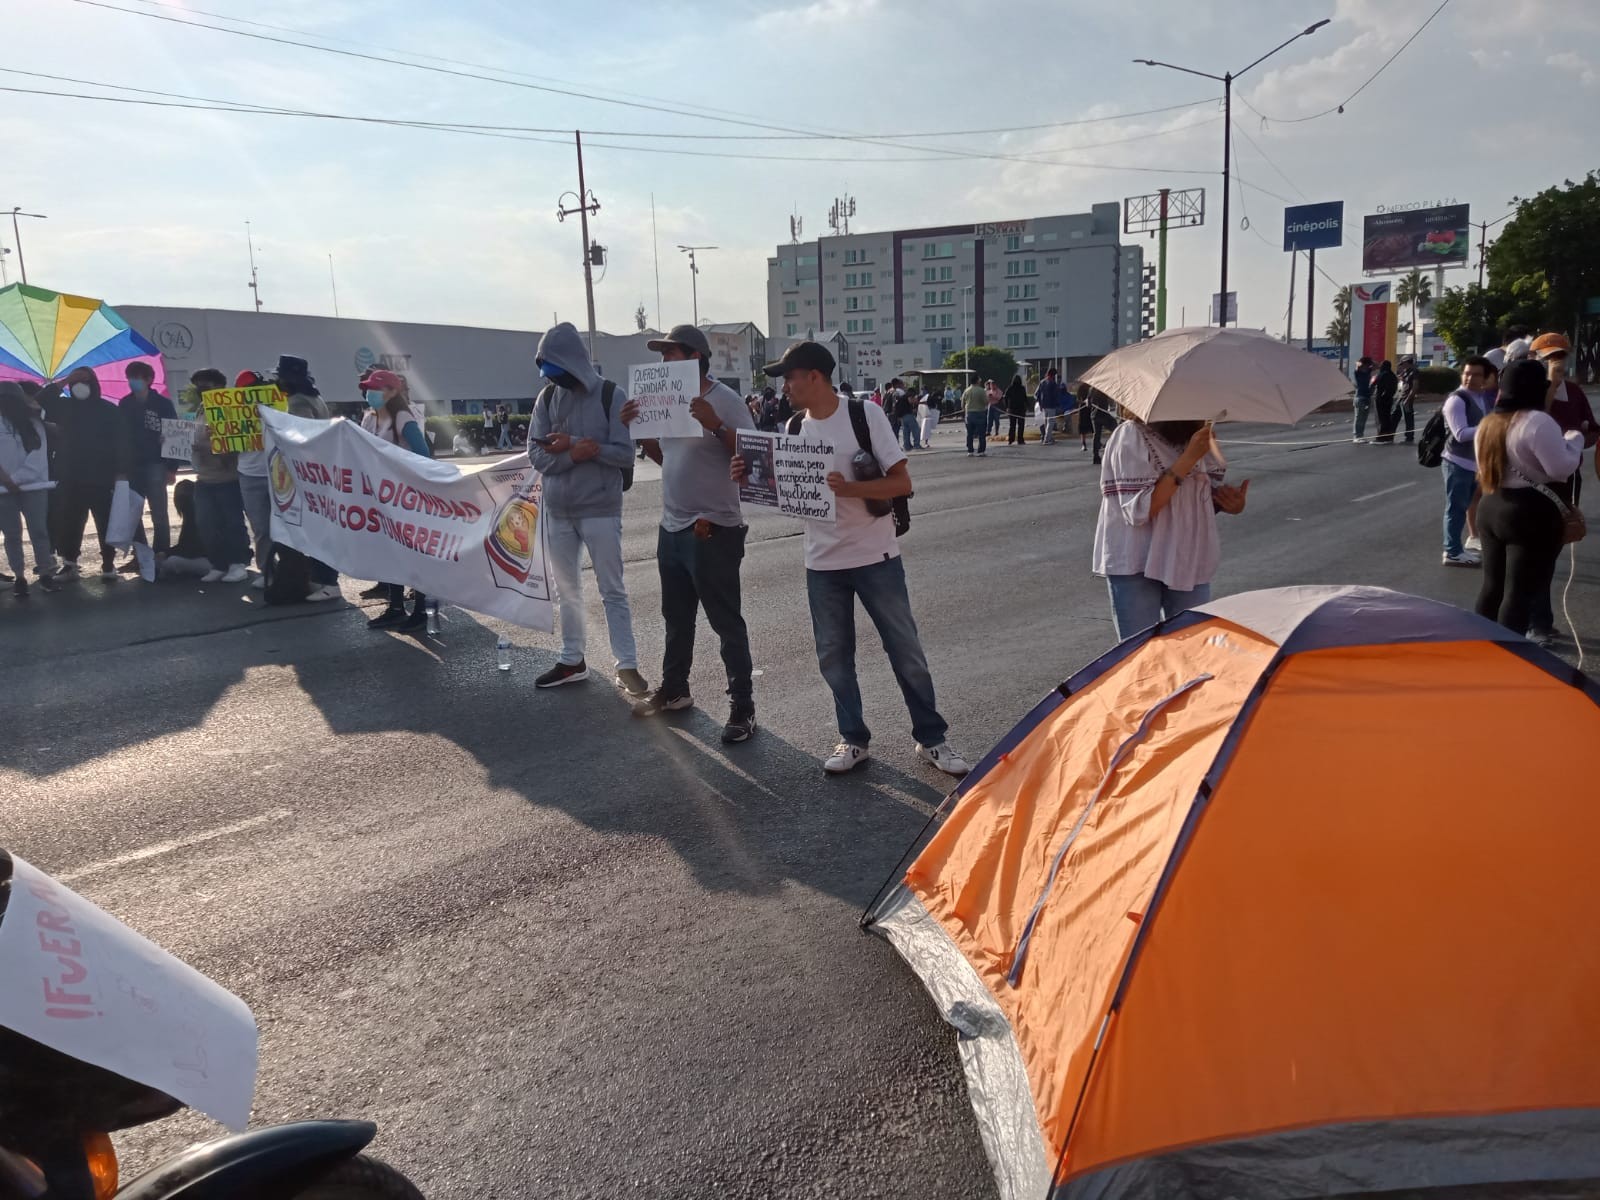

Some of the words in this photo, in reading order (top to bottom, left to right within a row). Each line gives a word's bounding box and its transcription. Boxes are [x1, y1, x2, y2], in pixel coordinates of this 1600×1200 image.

[1287, 217, 1339, 233] cinépolis
[634, 366, 669, 382] QUEREMOS
[633, 379, 668, 395] ESTUDIAR
[671, 379, 683, 391] NO
[203, 390, 232, 407] NOS
[678, 394, 689, 405] AL
[206, 405, 252, 421] TANTO
[635, 408, 672, 425] SISTEMA
[775, 460, 785, 468] en
[807, 461, 825, 472] pero
[814, 471, 825, 485] de
[292, 459, 333, 489] HASTA
[332, 464, 353, 493] QUE
[360, 471, 378, 501] LA
[378, 479, 483, 525] DIGNIDAD
[304, 491, 320, 515] SE
[338, 503, 464, 563] COSTUMBRE!!!
